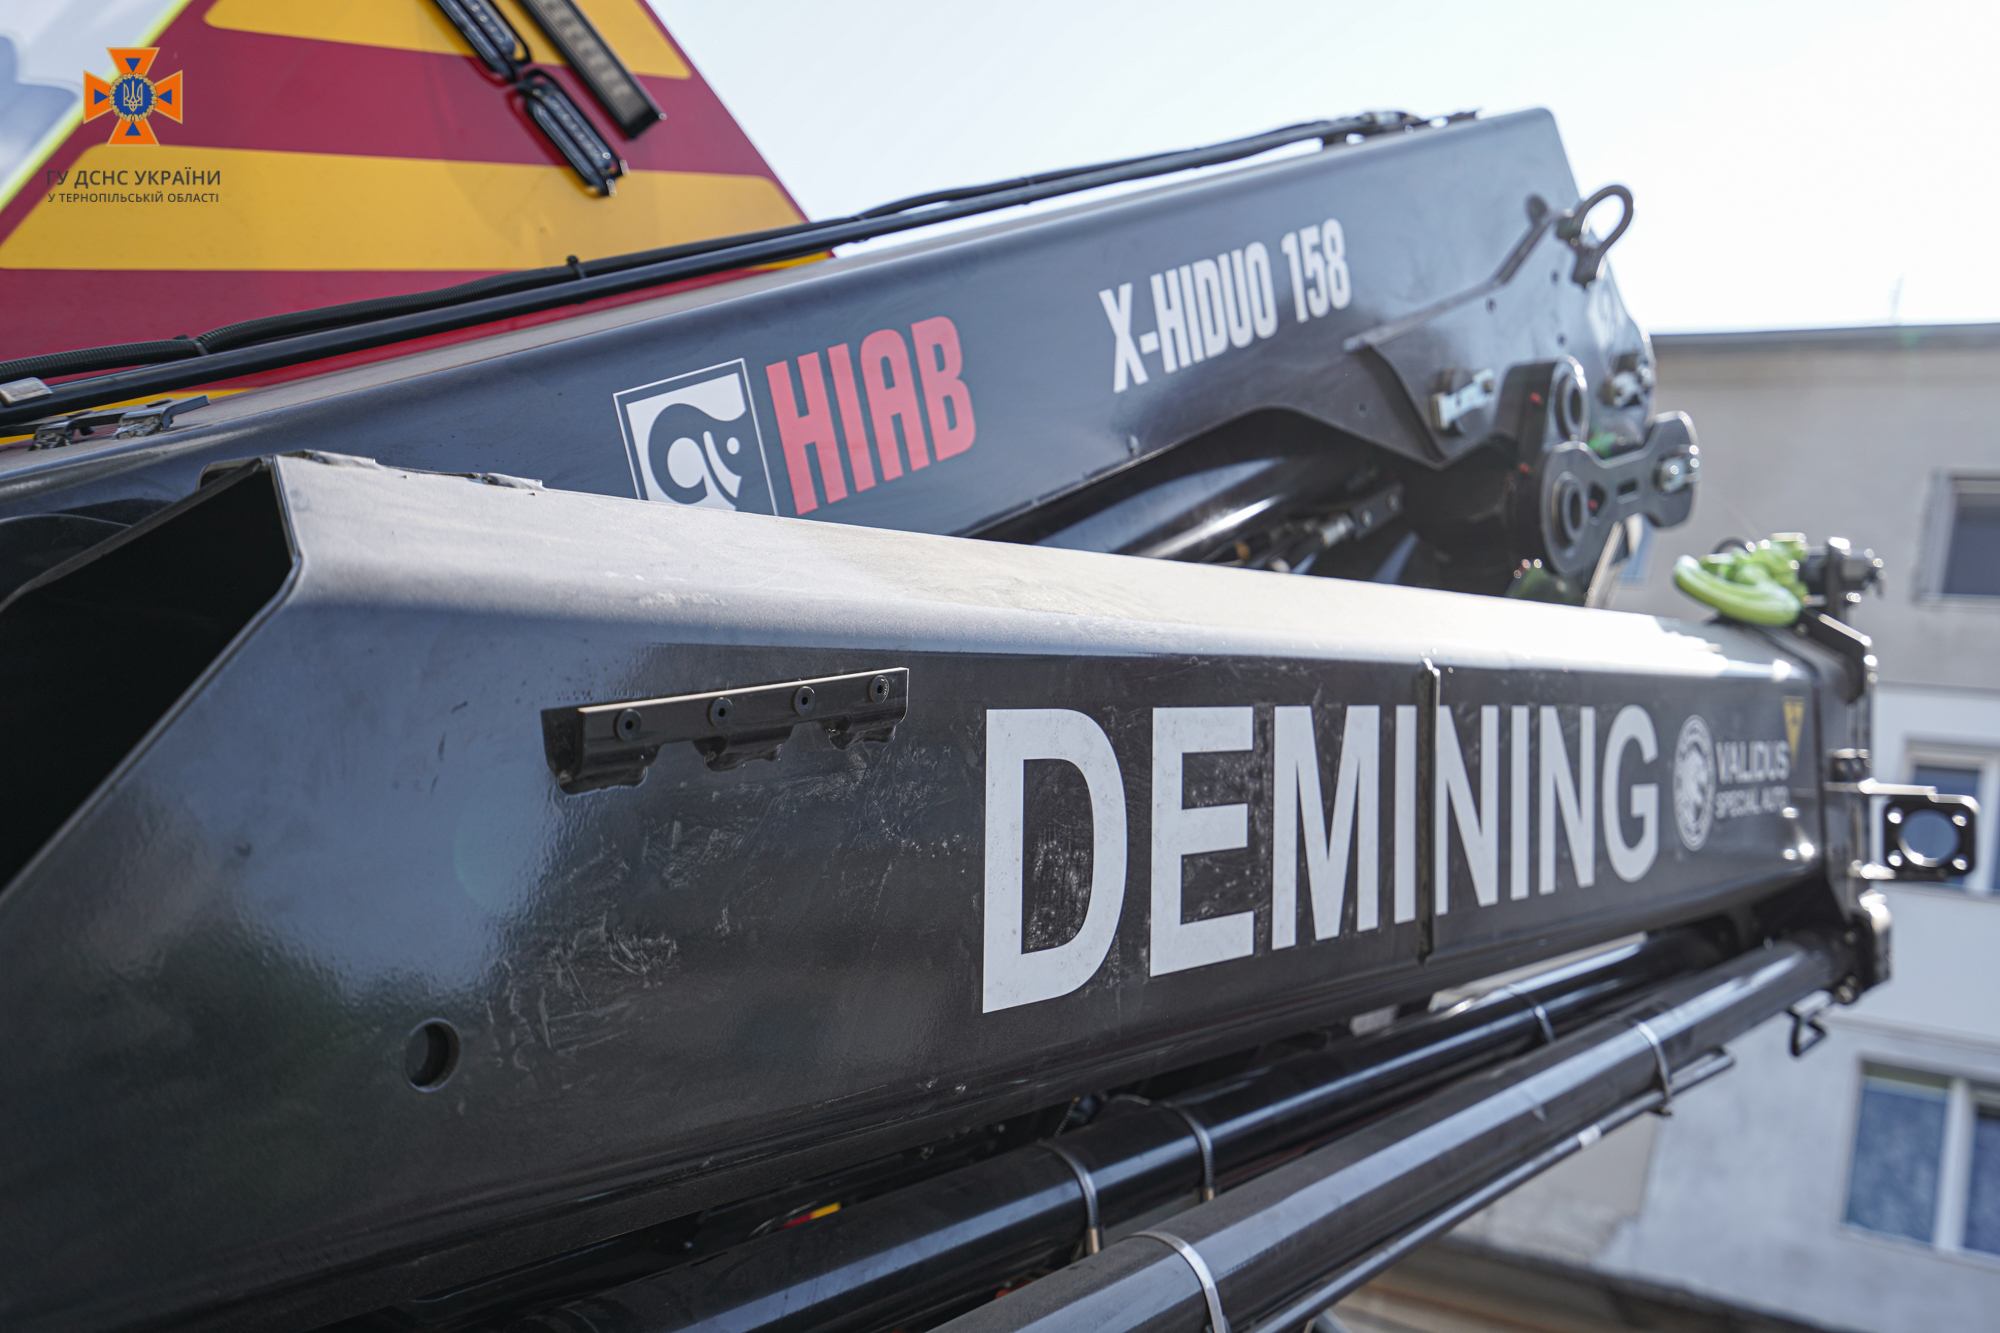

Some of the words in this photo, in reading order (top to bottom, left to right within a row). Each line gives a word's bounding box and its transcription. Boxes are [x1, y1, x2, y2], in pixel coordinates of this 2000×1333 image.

[1099, 242, 1278, 393] X-HIDUO
[1281, 218, 1352, 324] 158
[765, 315, 976, 515] HIAB
[1715, 740, 1790, 784] VALIDUS
[982, 704, 1660, 1014] DEMINING
